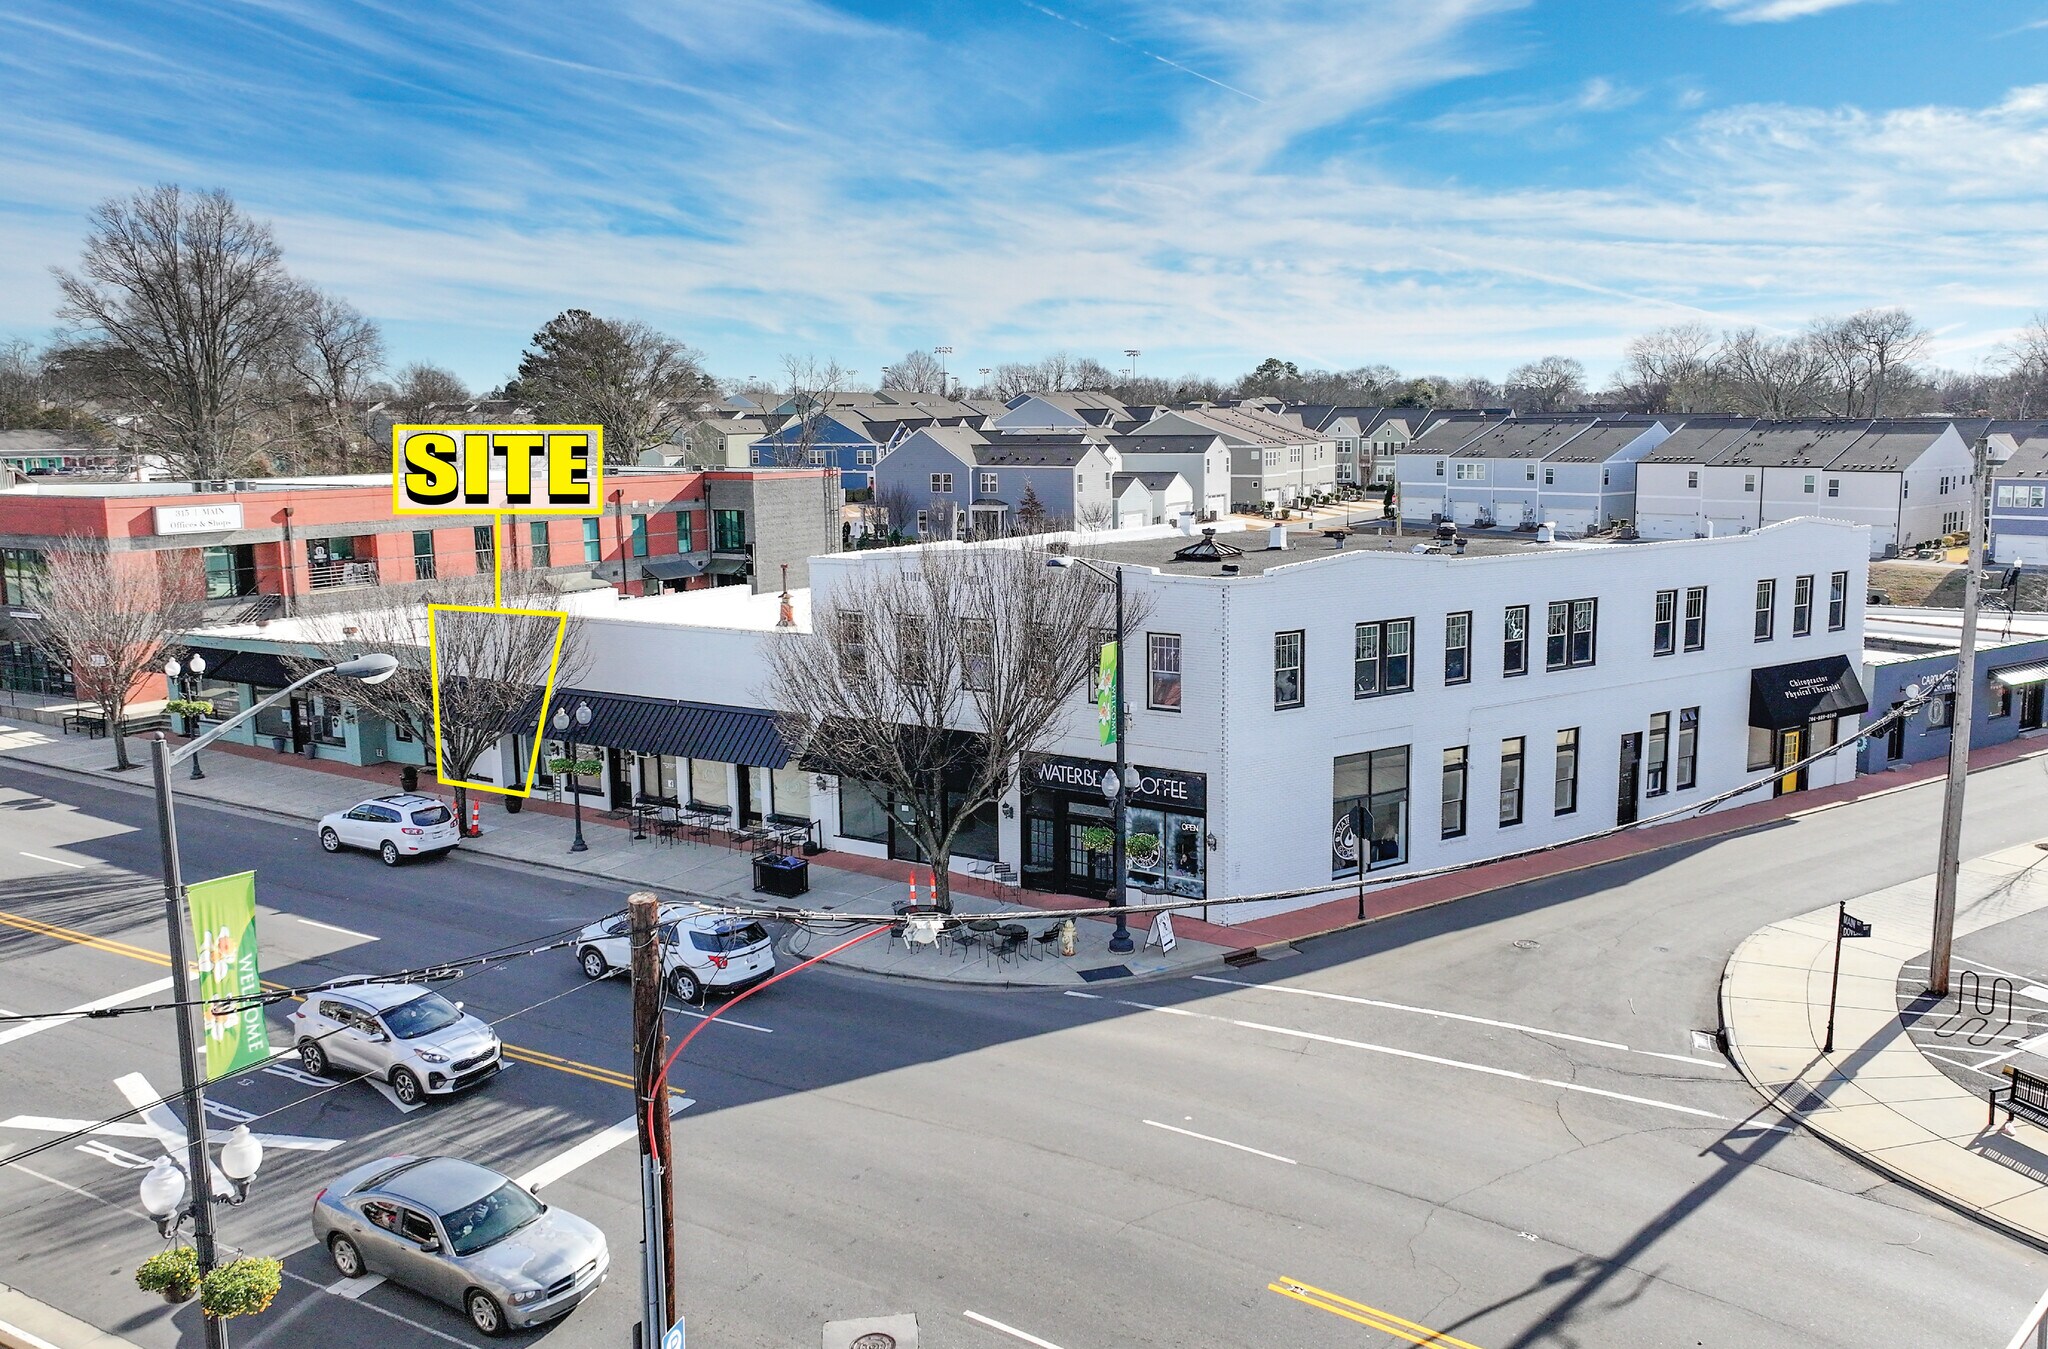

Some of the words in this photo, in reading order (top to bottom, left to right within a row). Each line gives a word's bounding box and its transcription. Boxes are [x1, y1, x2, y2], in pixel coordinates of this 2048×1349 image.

[202, 507, 225, 515] MAIN
[170, 521, 197, 529] Offices
[208, 519, 231, 528] Shops
[1789, 675, 1828, 687] Chiropractor
[1784, 687, 1812, 699] Physical
[1812, 683, 1841, 695] Therapist
[1038, 763, 1101, 787] WATERBE
[1133, 776, 1188, 800] OFFEE
[1181, 822, 1199, 832] OPEN
[239, 952, 264, 1053] WELOME
